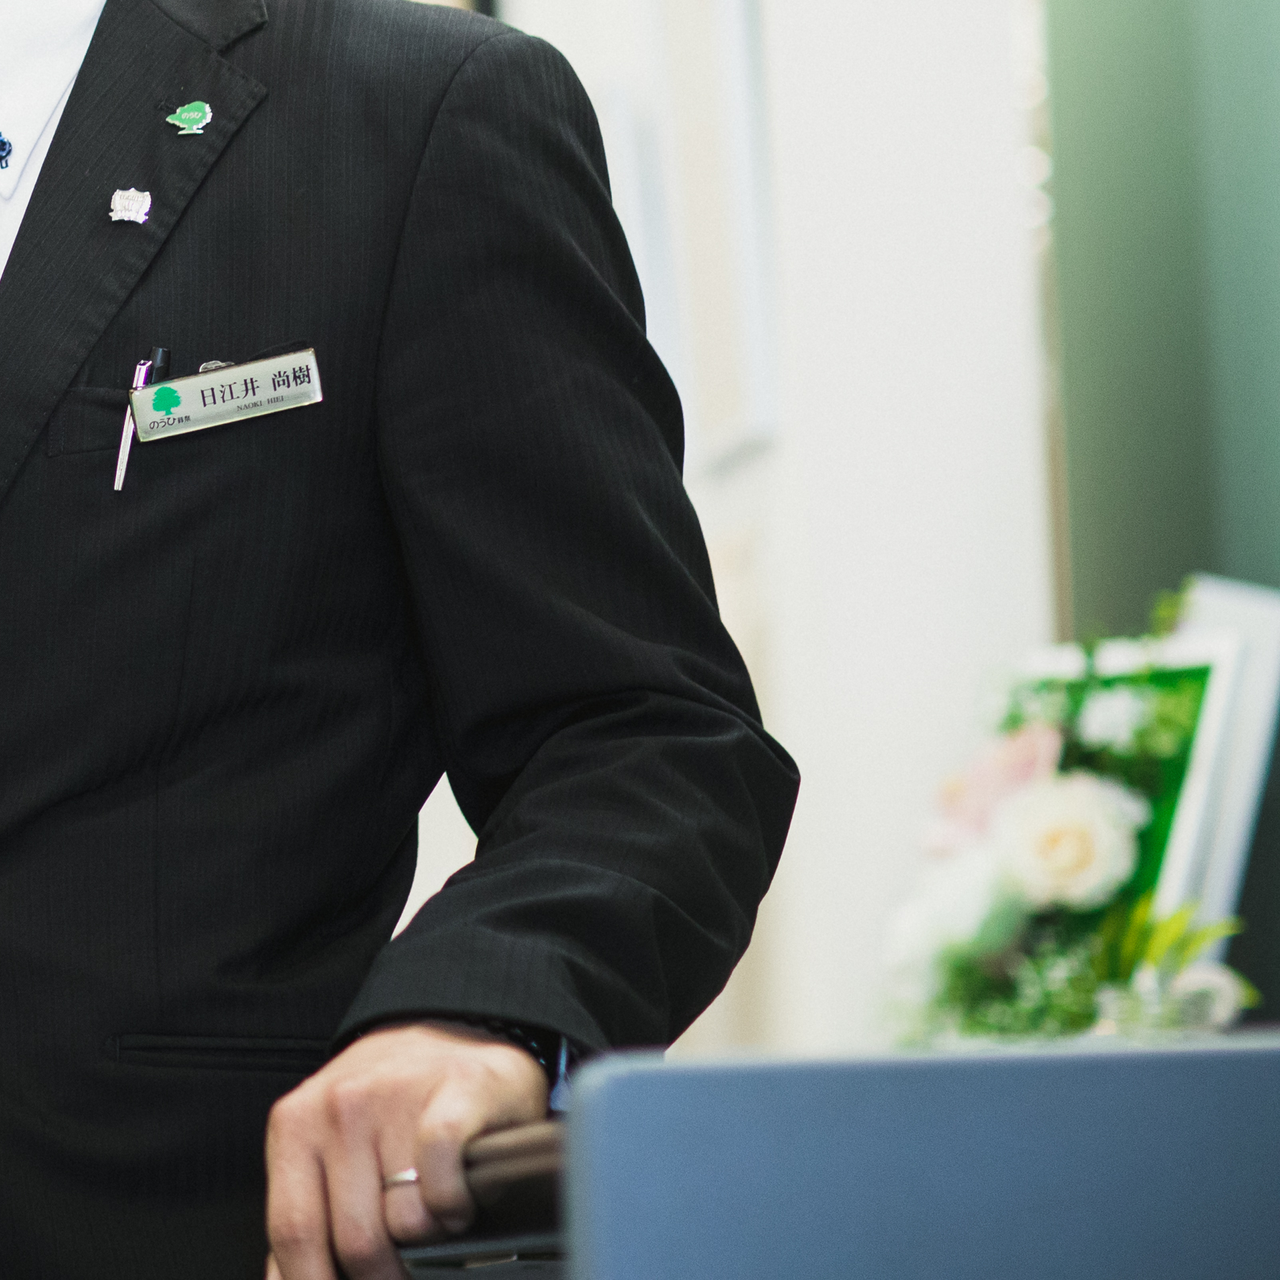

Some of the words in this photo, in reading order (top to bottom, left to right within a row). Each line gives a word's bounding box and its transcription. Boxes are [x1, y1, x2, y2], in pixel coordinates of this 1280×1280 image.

[200, 377, 260, 408] 日江井
[271, 364, 312, 392] 尚樹
[236, 400, 262, 411] NAOKI
